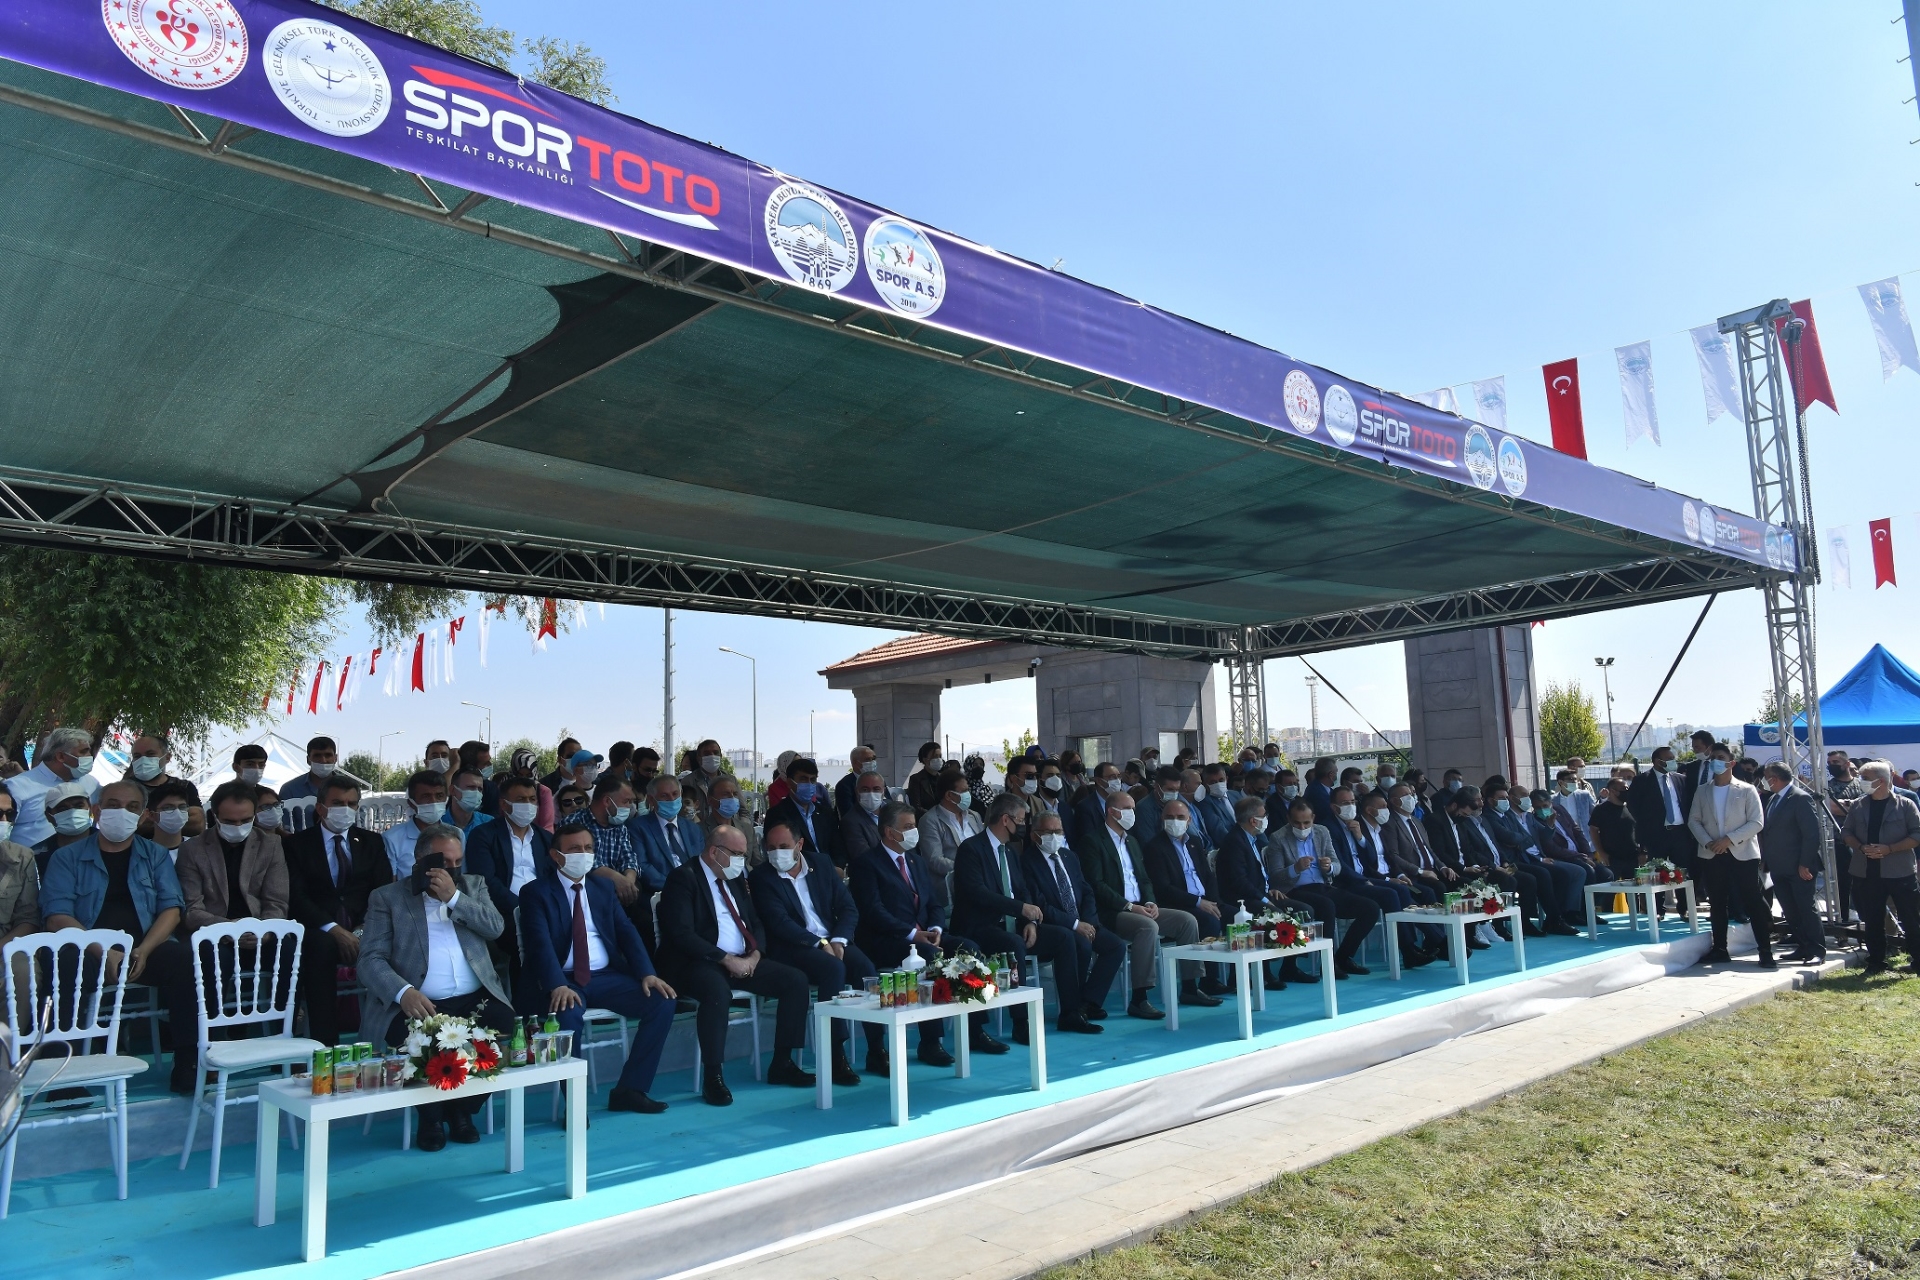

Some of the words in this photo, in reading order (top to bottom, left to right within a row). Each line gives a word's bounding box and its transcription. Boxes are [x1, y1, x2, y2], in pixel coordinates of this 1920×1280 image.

[204, 7, 215, 17] VE
[211, 18, 223, 40] SPOR
[272, 27, 305, 77] GELENEKSEL
[340, 36, 381, 81] OKÇULUK
[336, 83, 384, 129] FEDERASYONU
[406, 126, 480, 156] TEŞKİLAT
[487, 151, 574, 186] BAŞKANLIĞI
[768, 198, 782, 248] KAYSERİ
[833, 209, 858, 274] BELEDİYESİ
[801, 273, 832, 290] 1869
[875, 268, 911, 291] SPOR
[900, 298, 917, 309] 2010
